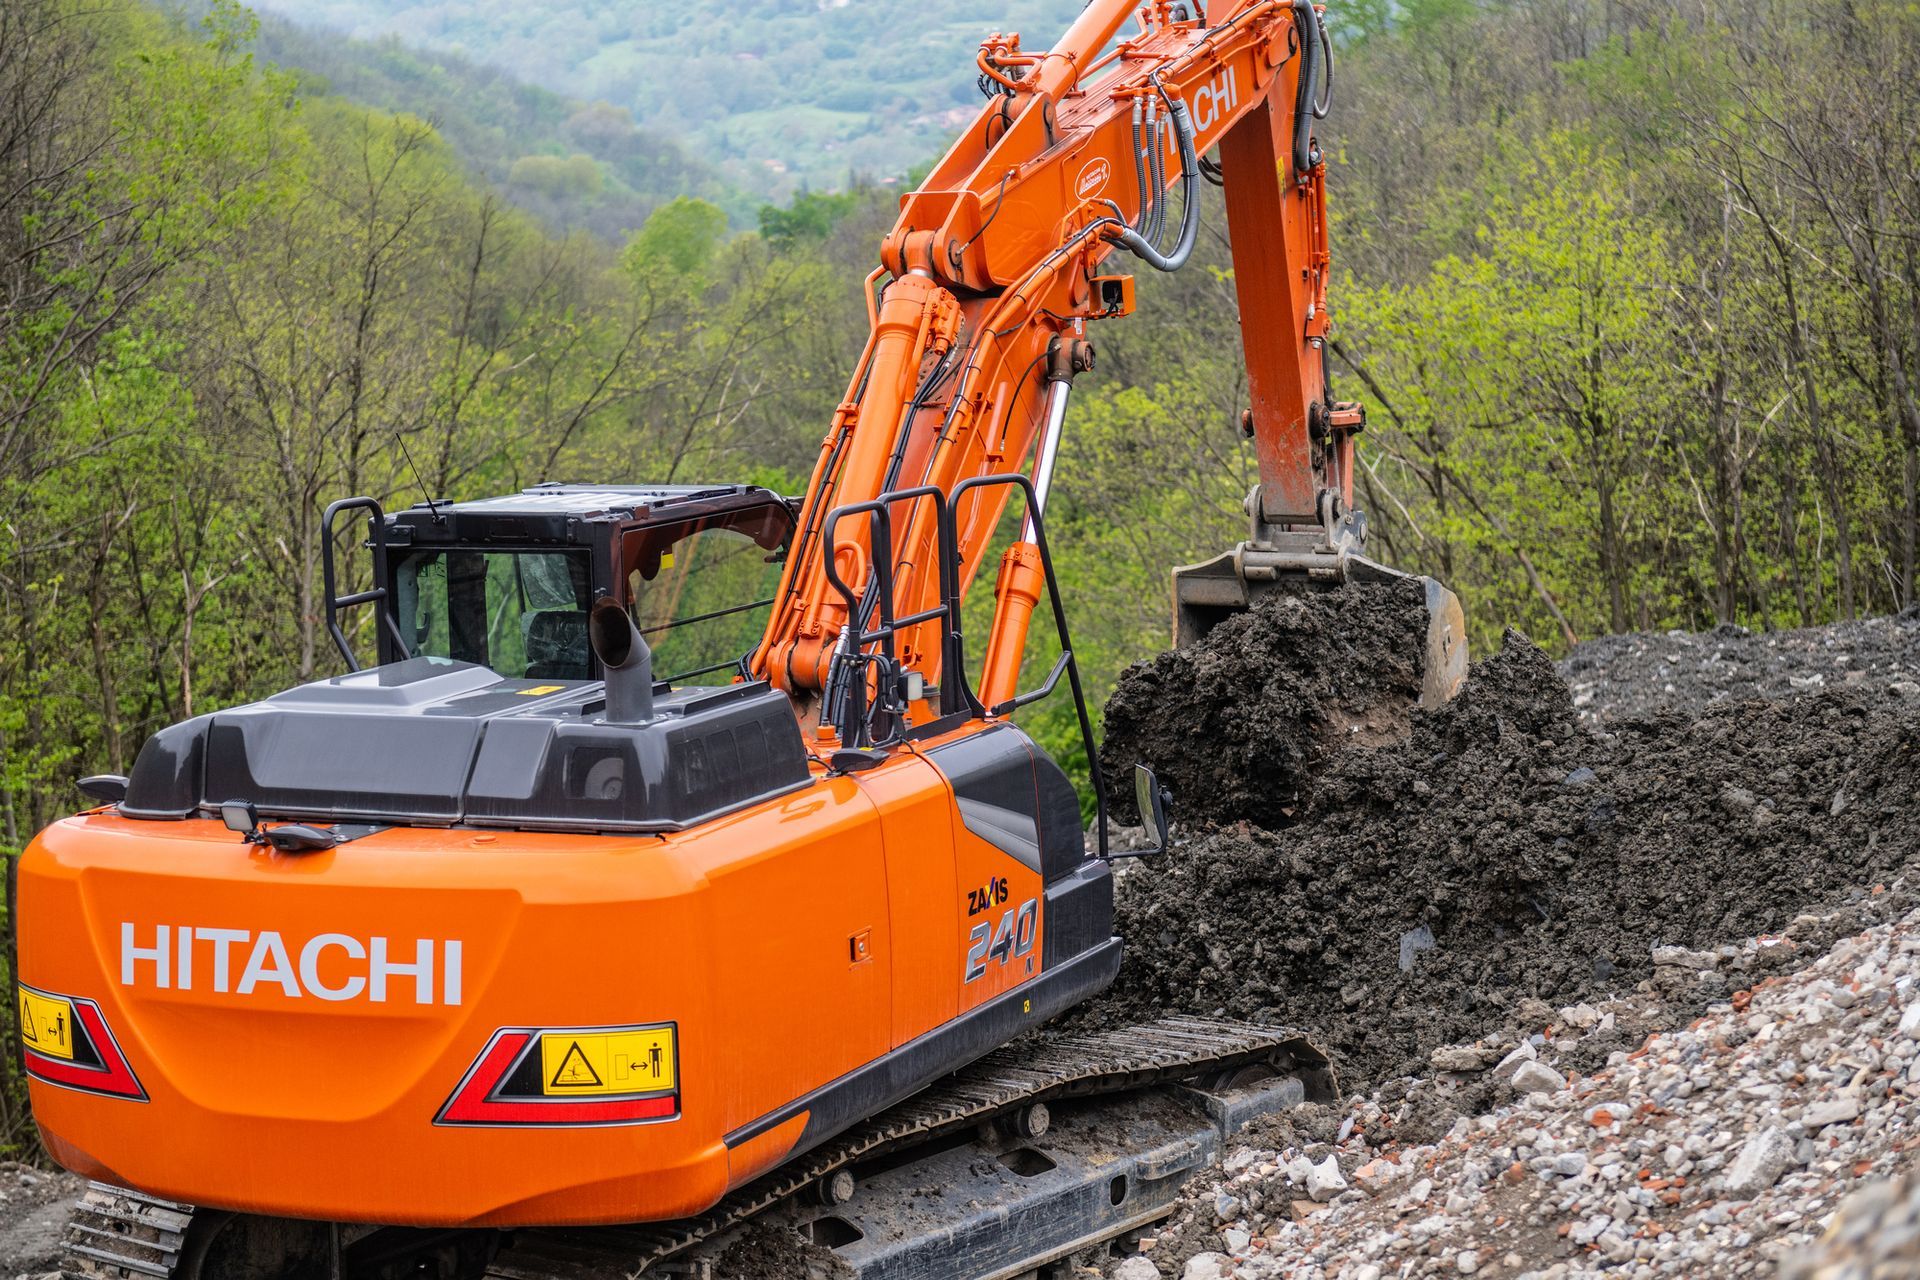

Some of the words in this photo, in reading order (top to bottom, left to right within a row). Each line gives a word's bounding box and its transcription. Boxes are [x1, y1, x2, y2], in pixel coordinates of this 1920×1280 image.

[968, 877, 1008, 917] ZAXIS
[120, 922, 463, 1006] HITACHI
[964, 898, 1039, 984] 240
